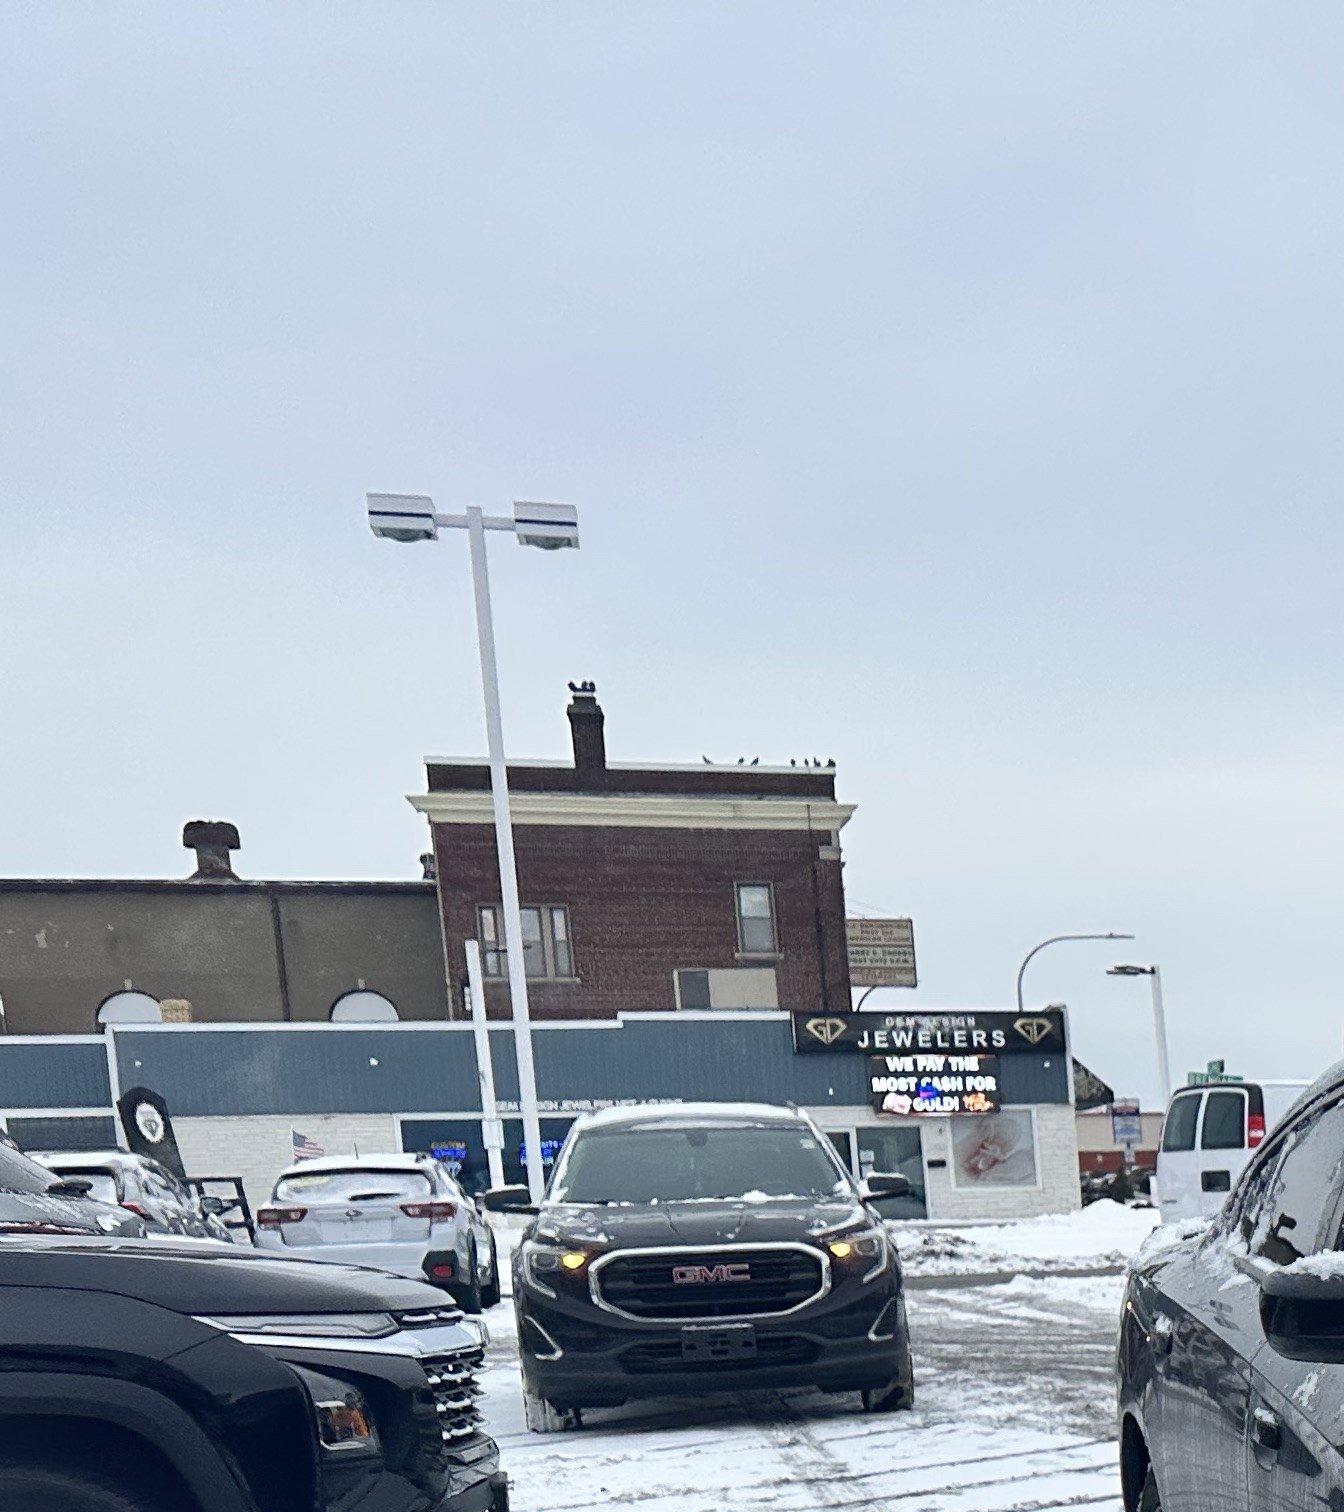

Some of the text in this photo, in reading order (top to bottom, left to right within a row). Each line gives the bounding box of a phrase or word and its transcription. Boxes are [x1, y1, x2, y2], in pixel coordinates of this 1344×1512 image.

[857, 1029, 1007, 1048] JEWELERS
[885, 1056, 980, 1072] WE PAY THE
[872, 1076, 919, 1092] MOST
[965, 1075, 997, 1092] FOR
[672, 1263, 751, 1284] GMC
